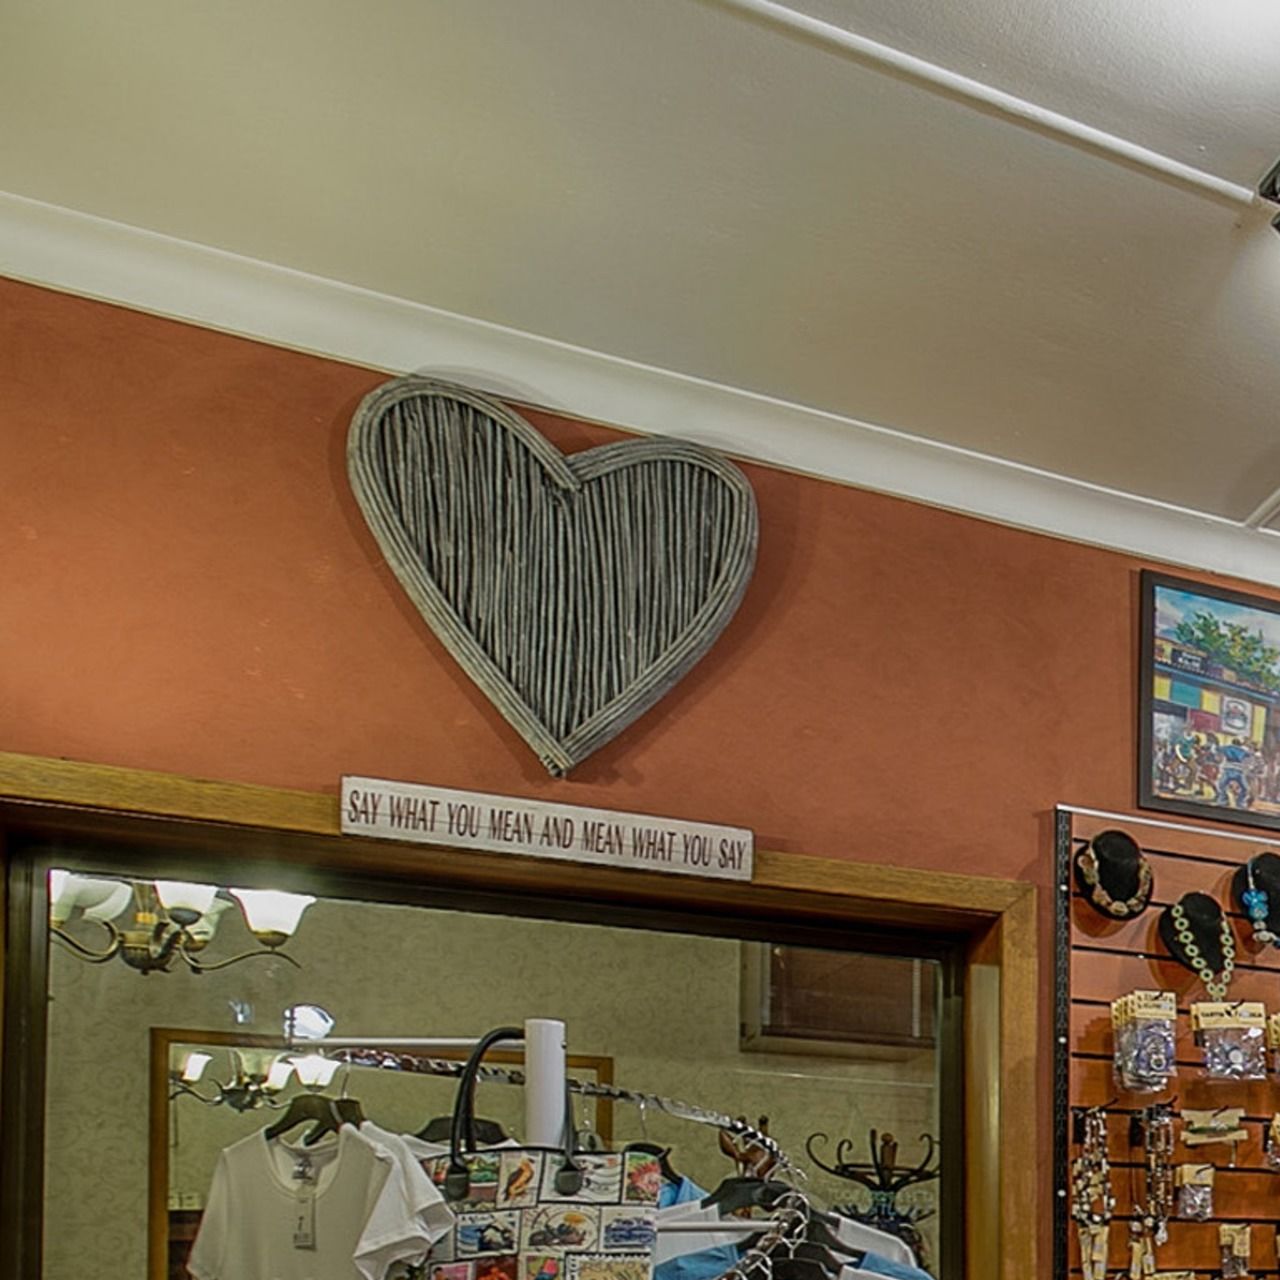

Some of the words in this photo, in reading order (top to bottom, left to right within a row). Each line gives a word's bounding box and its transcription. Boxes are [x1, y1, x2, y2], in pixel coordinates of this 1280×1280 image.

[349, 790, 381, 825] SAY
[389, 795, 439, 832] WHAT
[448, 803, 481, 838] YOU
[489, 809, 534, 845] MEAN
[540, 816, 574, 850] AND
[583, 820, 625, 856] MEAN
[632, 827, 677, 862] WHAT
[683, 833, 713, 867] YOU
[718, 838, 747, 871] SAY
